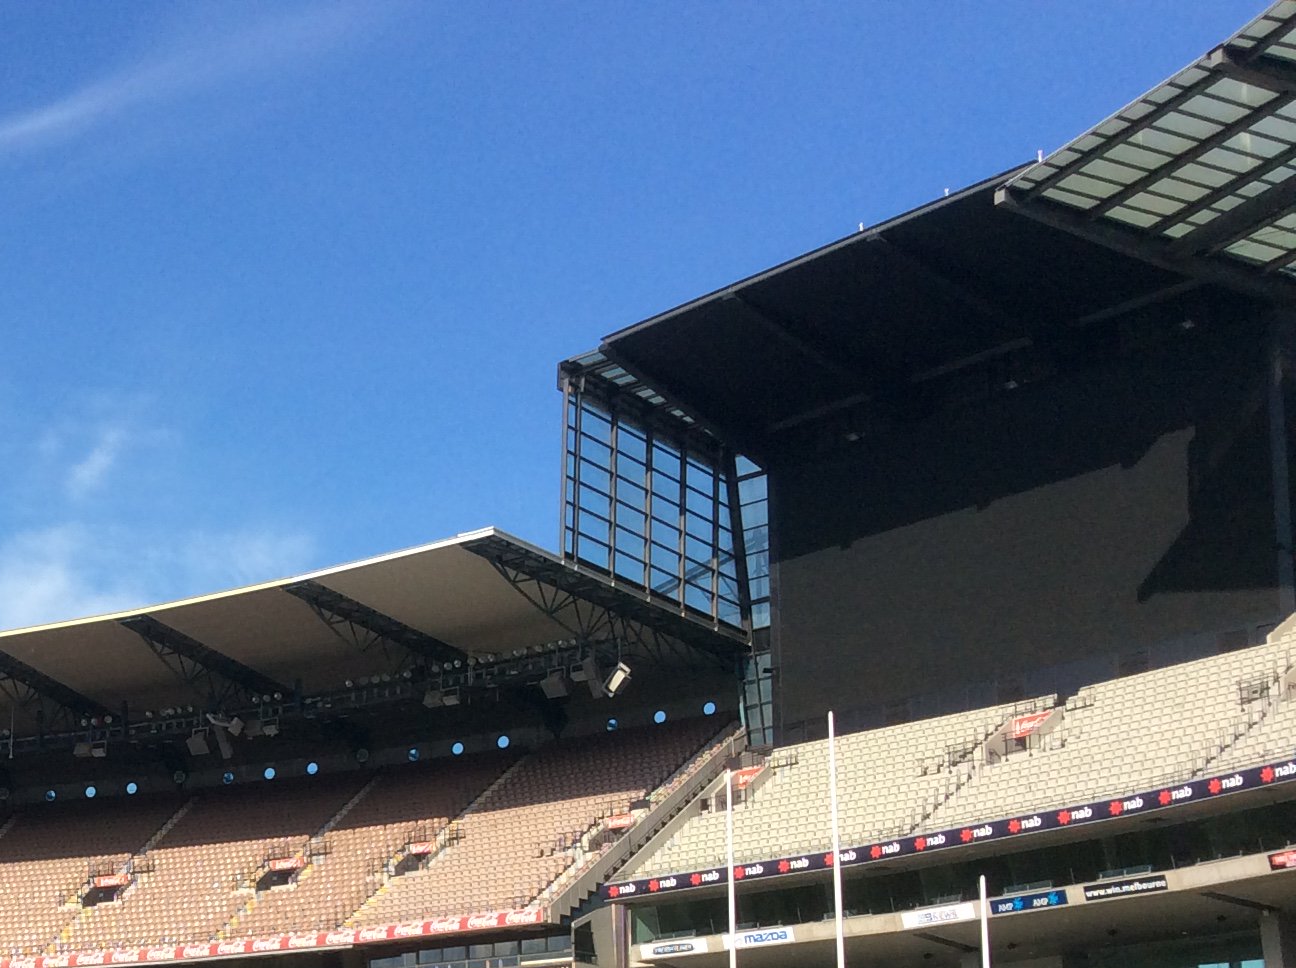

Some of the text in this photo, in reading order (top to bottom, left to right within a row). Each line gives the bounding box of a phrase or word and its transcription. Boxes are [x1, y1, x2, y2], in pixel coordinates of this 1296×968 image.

[619, 762, 1296, 894] nab nab nab nab nab nab nab nab nab nab nab nab nab nab nab
